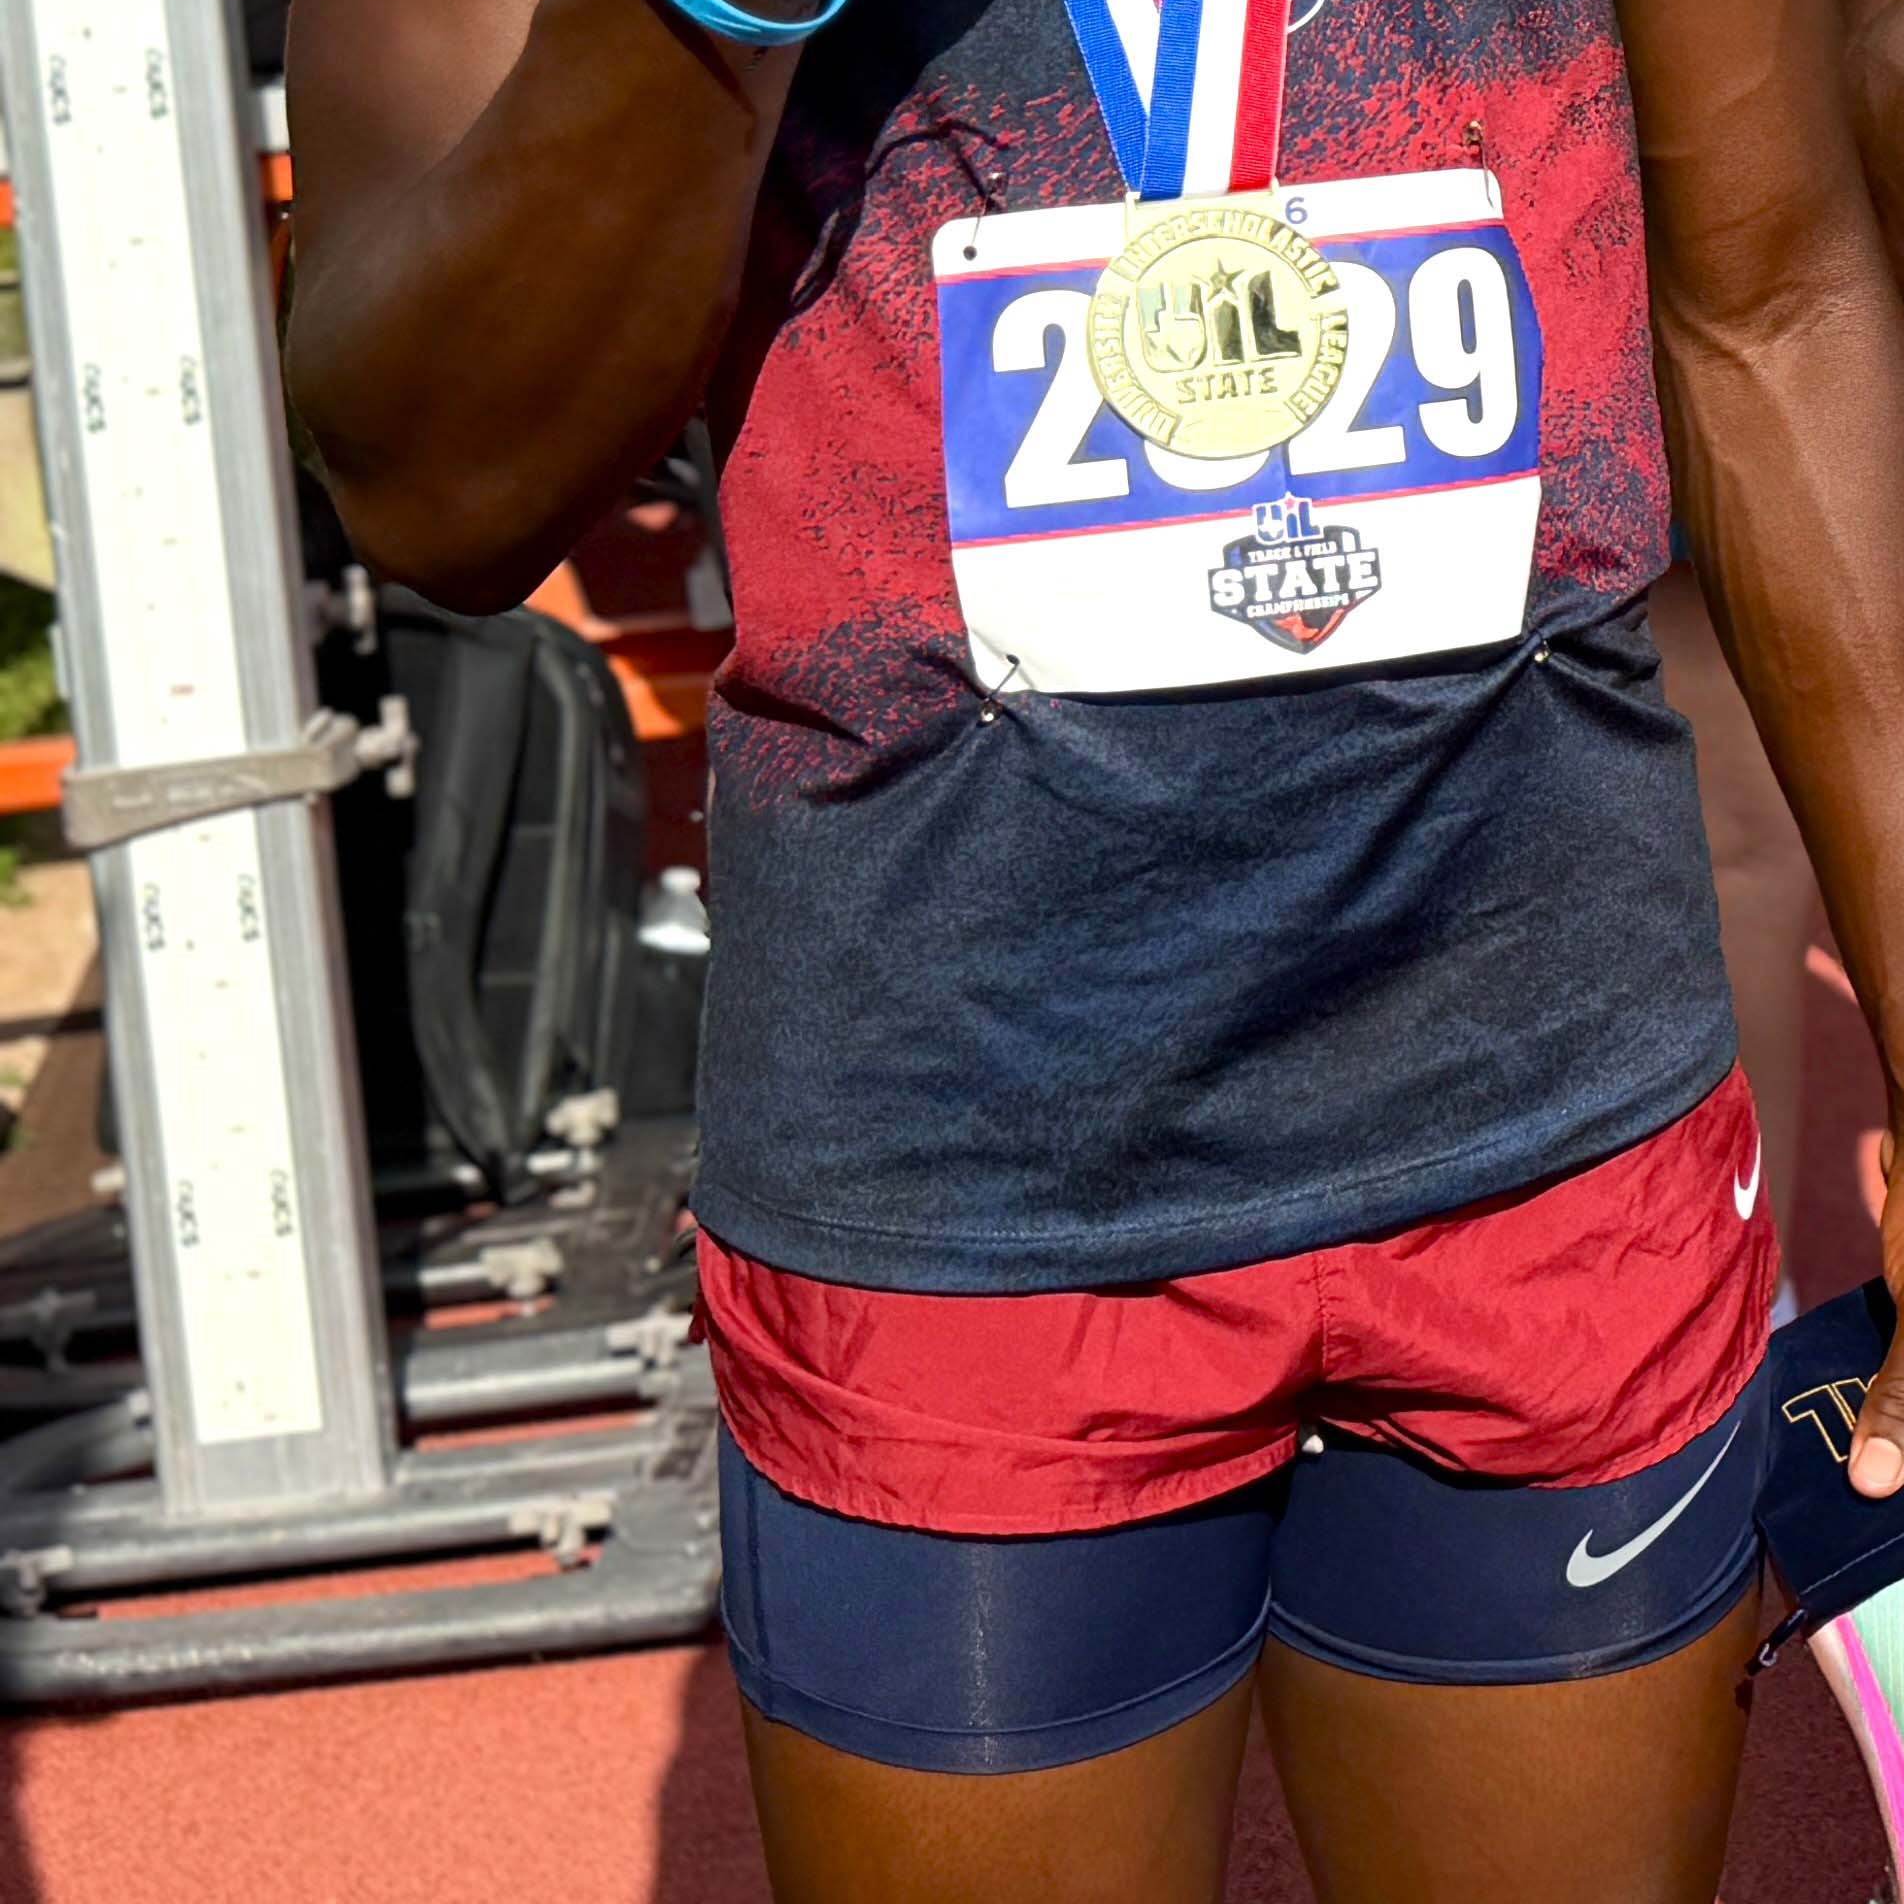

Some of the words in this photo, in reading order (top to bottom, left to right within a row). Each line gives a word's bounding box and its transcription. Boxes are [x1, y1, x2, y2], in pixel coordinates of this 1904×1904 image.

[992, 248, 1519, 509] 229
[1175, 367, 1279, 405] STATE
[1211, 551, 1379, 608] STATE
